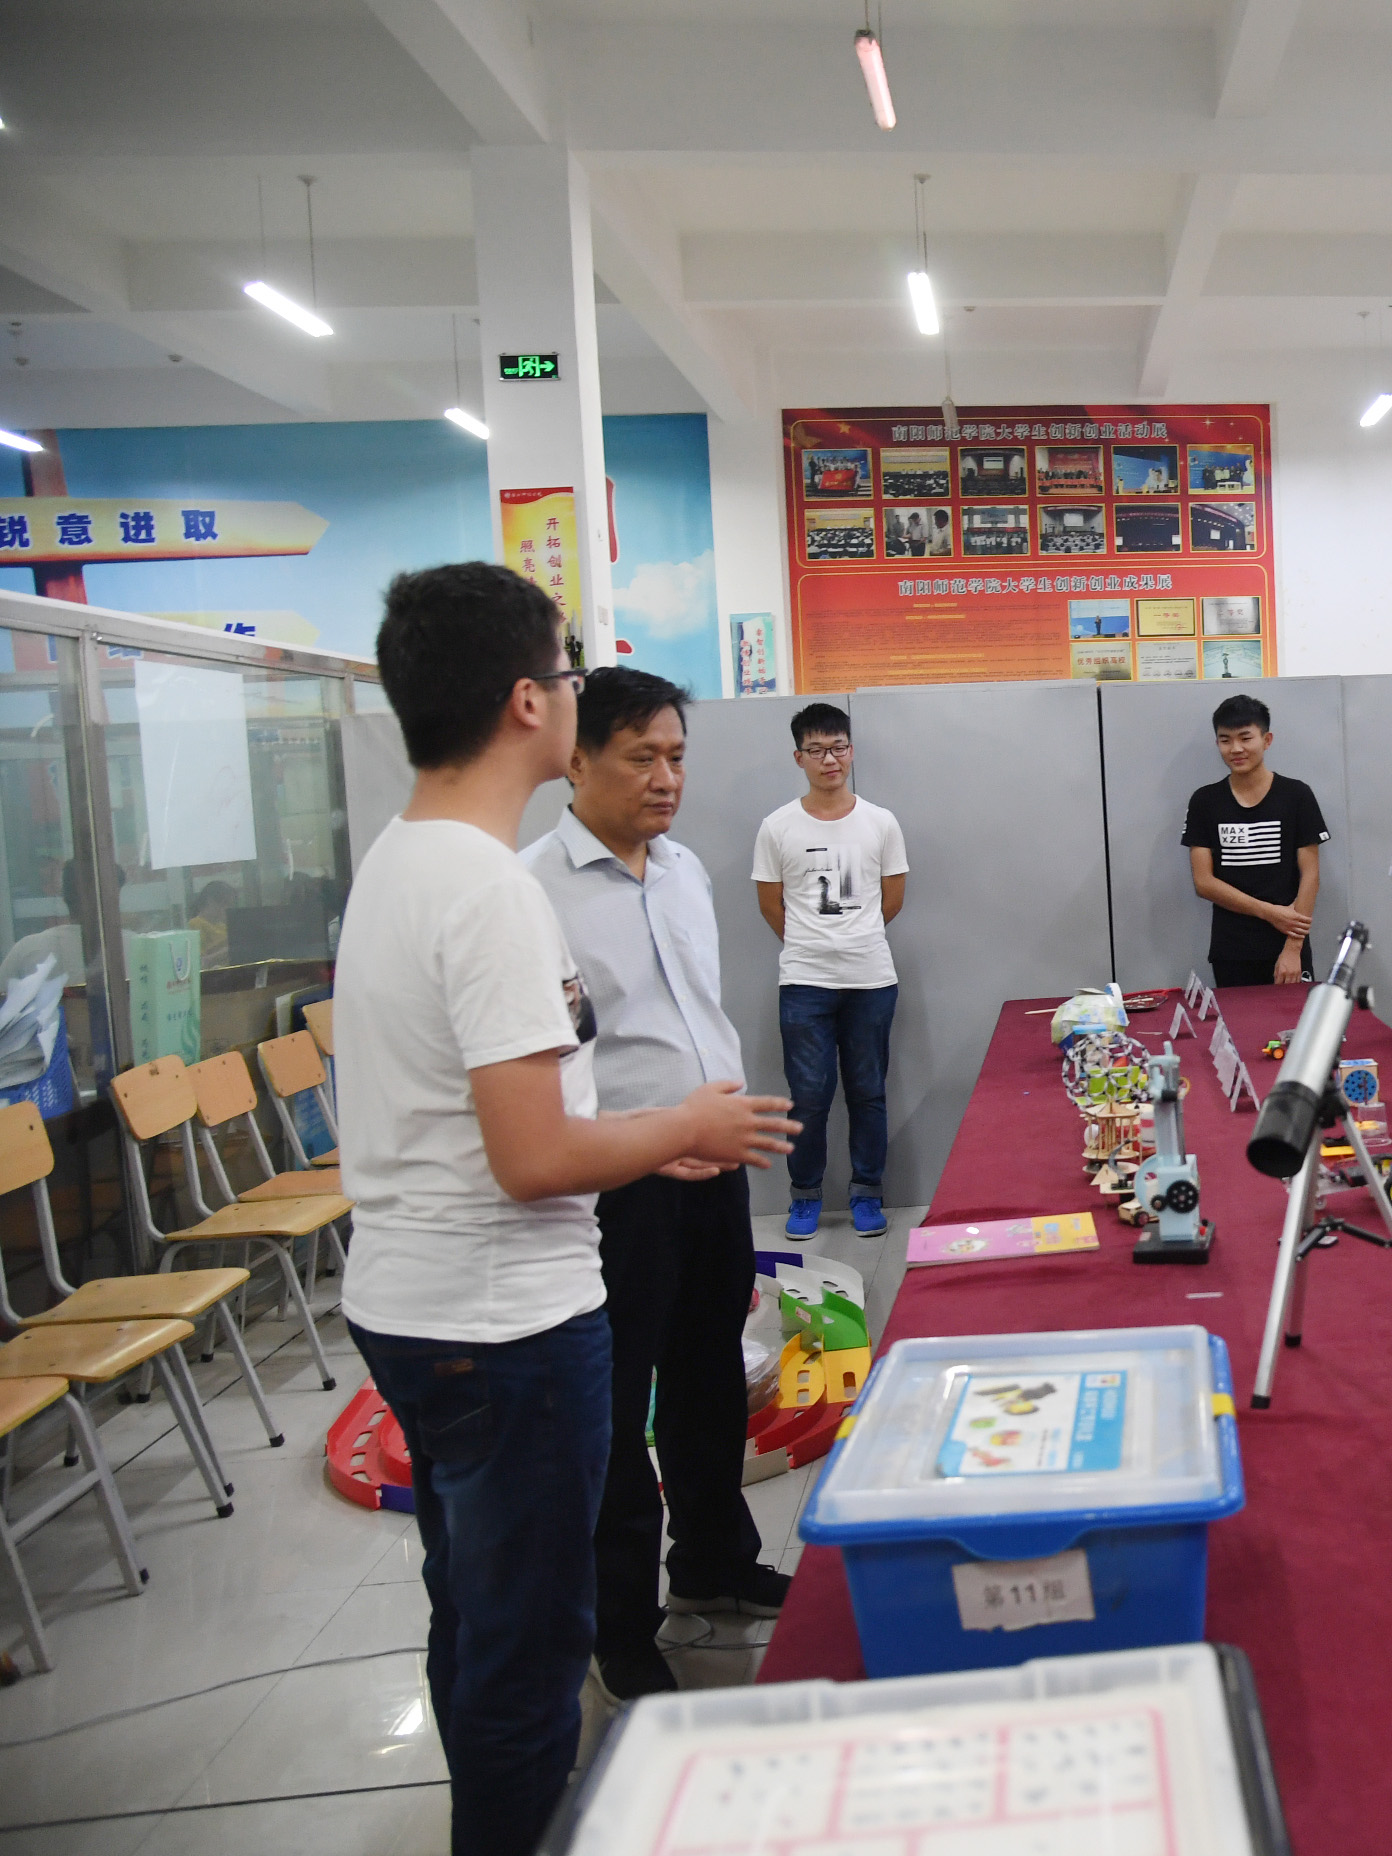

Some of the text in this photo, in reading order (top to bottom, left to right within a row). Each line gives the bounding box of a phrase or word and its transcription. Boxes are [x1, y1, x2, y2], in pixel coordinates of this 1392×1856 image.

[891, 422, 1168, 441] 南阳师范学院大学生创新创业活动展
[0, 508, 219, 548] 锐意进取
[897, 574, 1173, 596] 南阳师范学院大学生创新创业成果展
[1221, 826, 1245, 835] MAX
[1222, 835, 1246, 844] XZE
